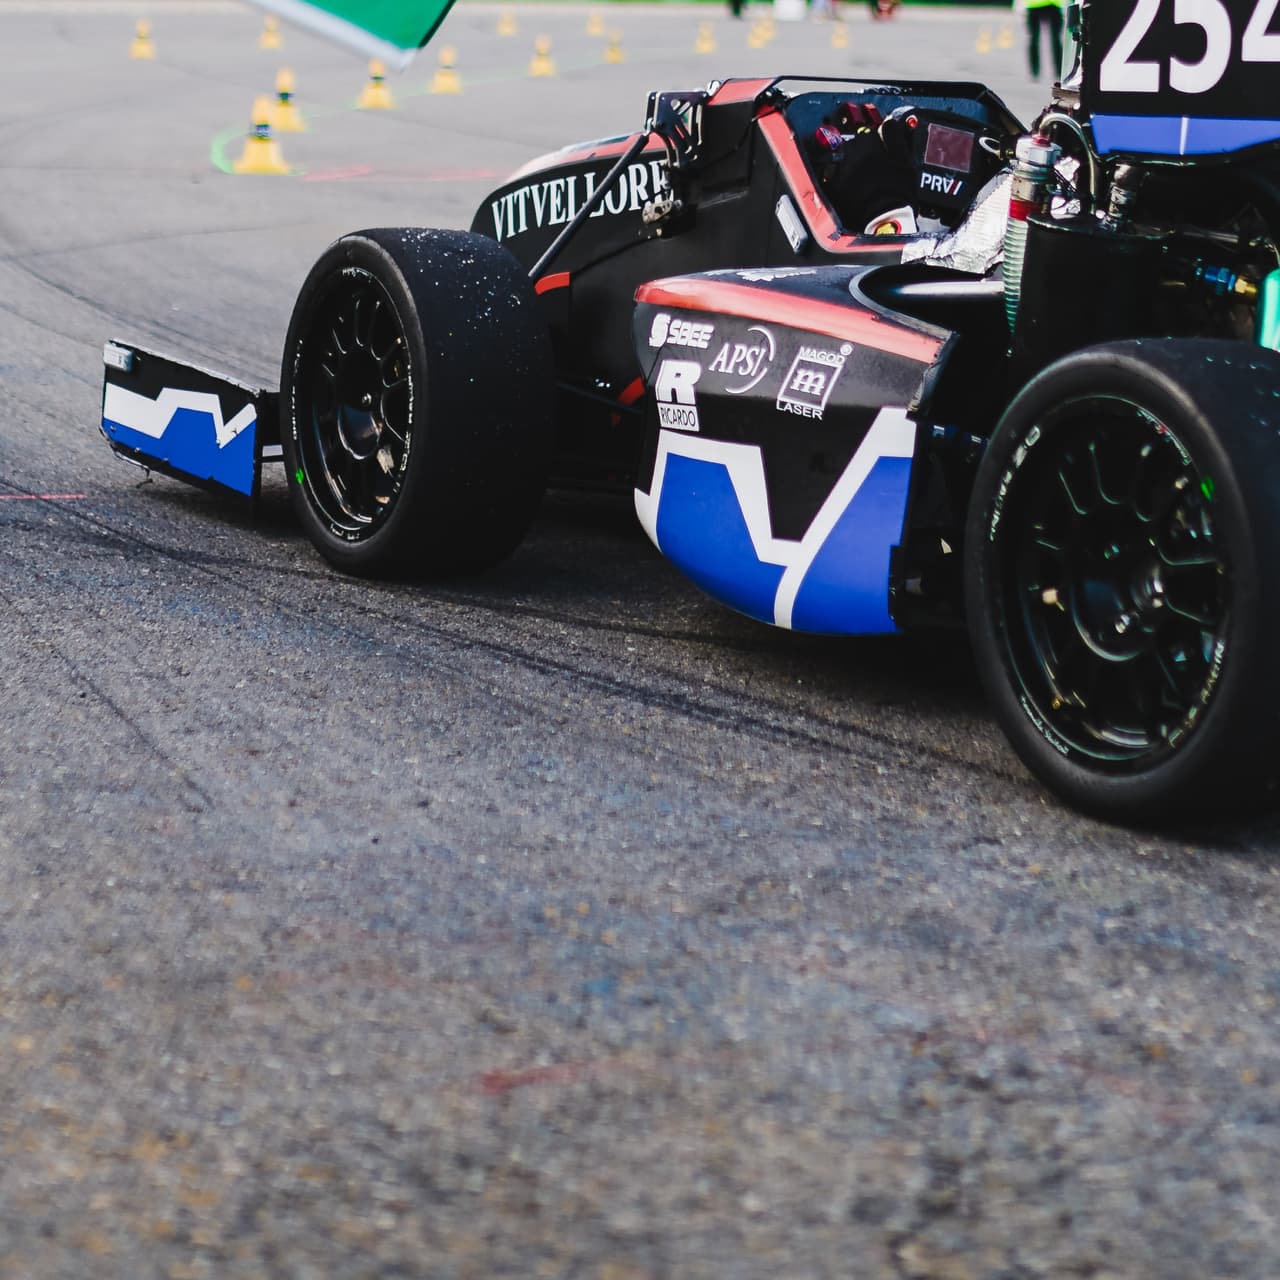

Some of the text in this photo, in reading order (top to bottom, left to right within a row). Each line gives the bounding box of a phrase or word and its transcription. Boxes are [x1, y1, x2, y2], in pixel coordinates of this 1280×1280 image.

[708, 342, 766, 377] APSI
[798, 346, 846, 366] MAGOD
[660, 406, 697, 428] RICARDO
[776, 399, 824, 421] LASER
